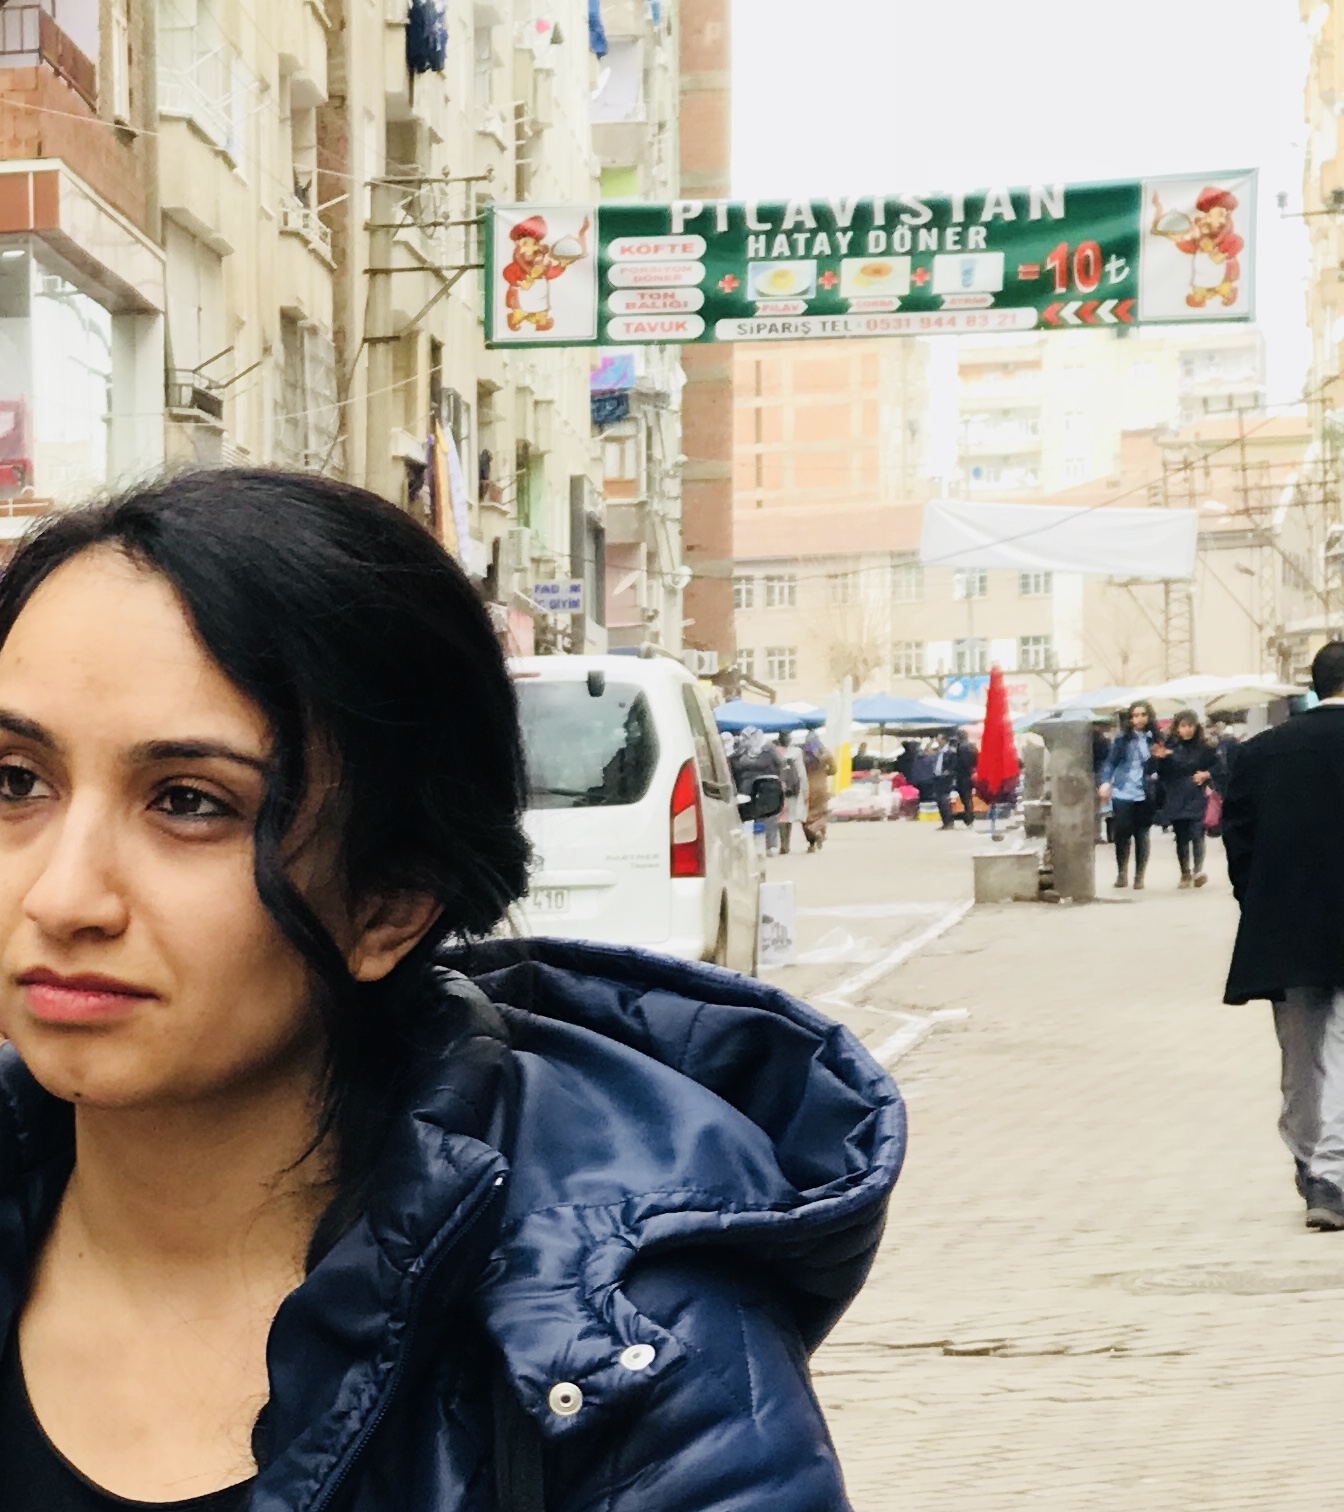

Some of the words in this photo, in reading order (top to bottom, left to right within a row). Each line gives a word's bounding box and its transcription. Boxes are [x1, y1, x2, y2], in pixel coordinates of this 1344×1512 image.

[619, 240, 696, 256] KÖFTE
[747, 230, 854, 258] HATAY
[868, 224, 989, 254] DÖNER
[636, 290, 676, 301] TON
[622, 319, 690, 335] TAVUK
[865, 316, 911, 332] 0531
[919, 314, 957, 328] 944
